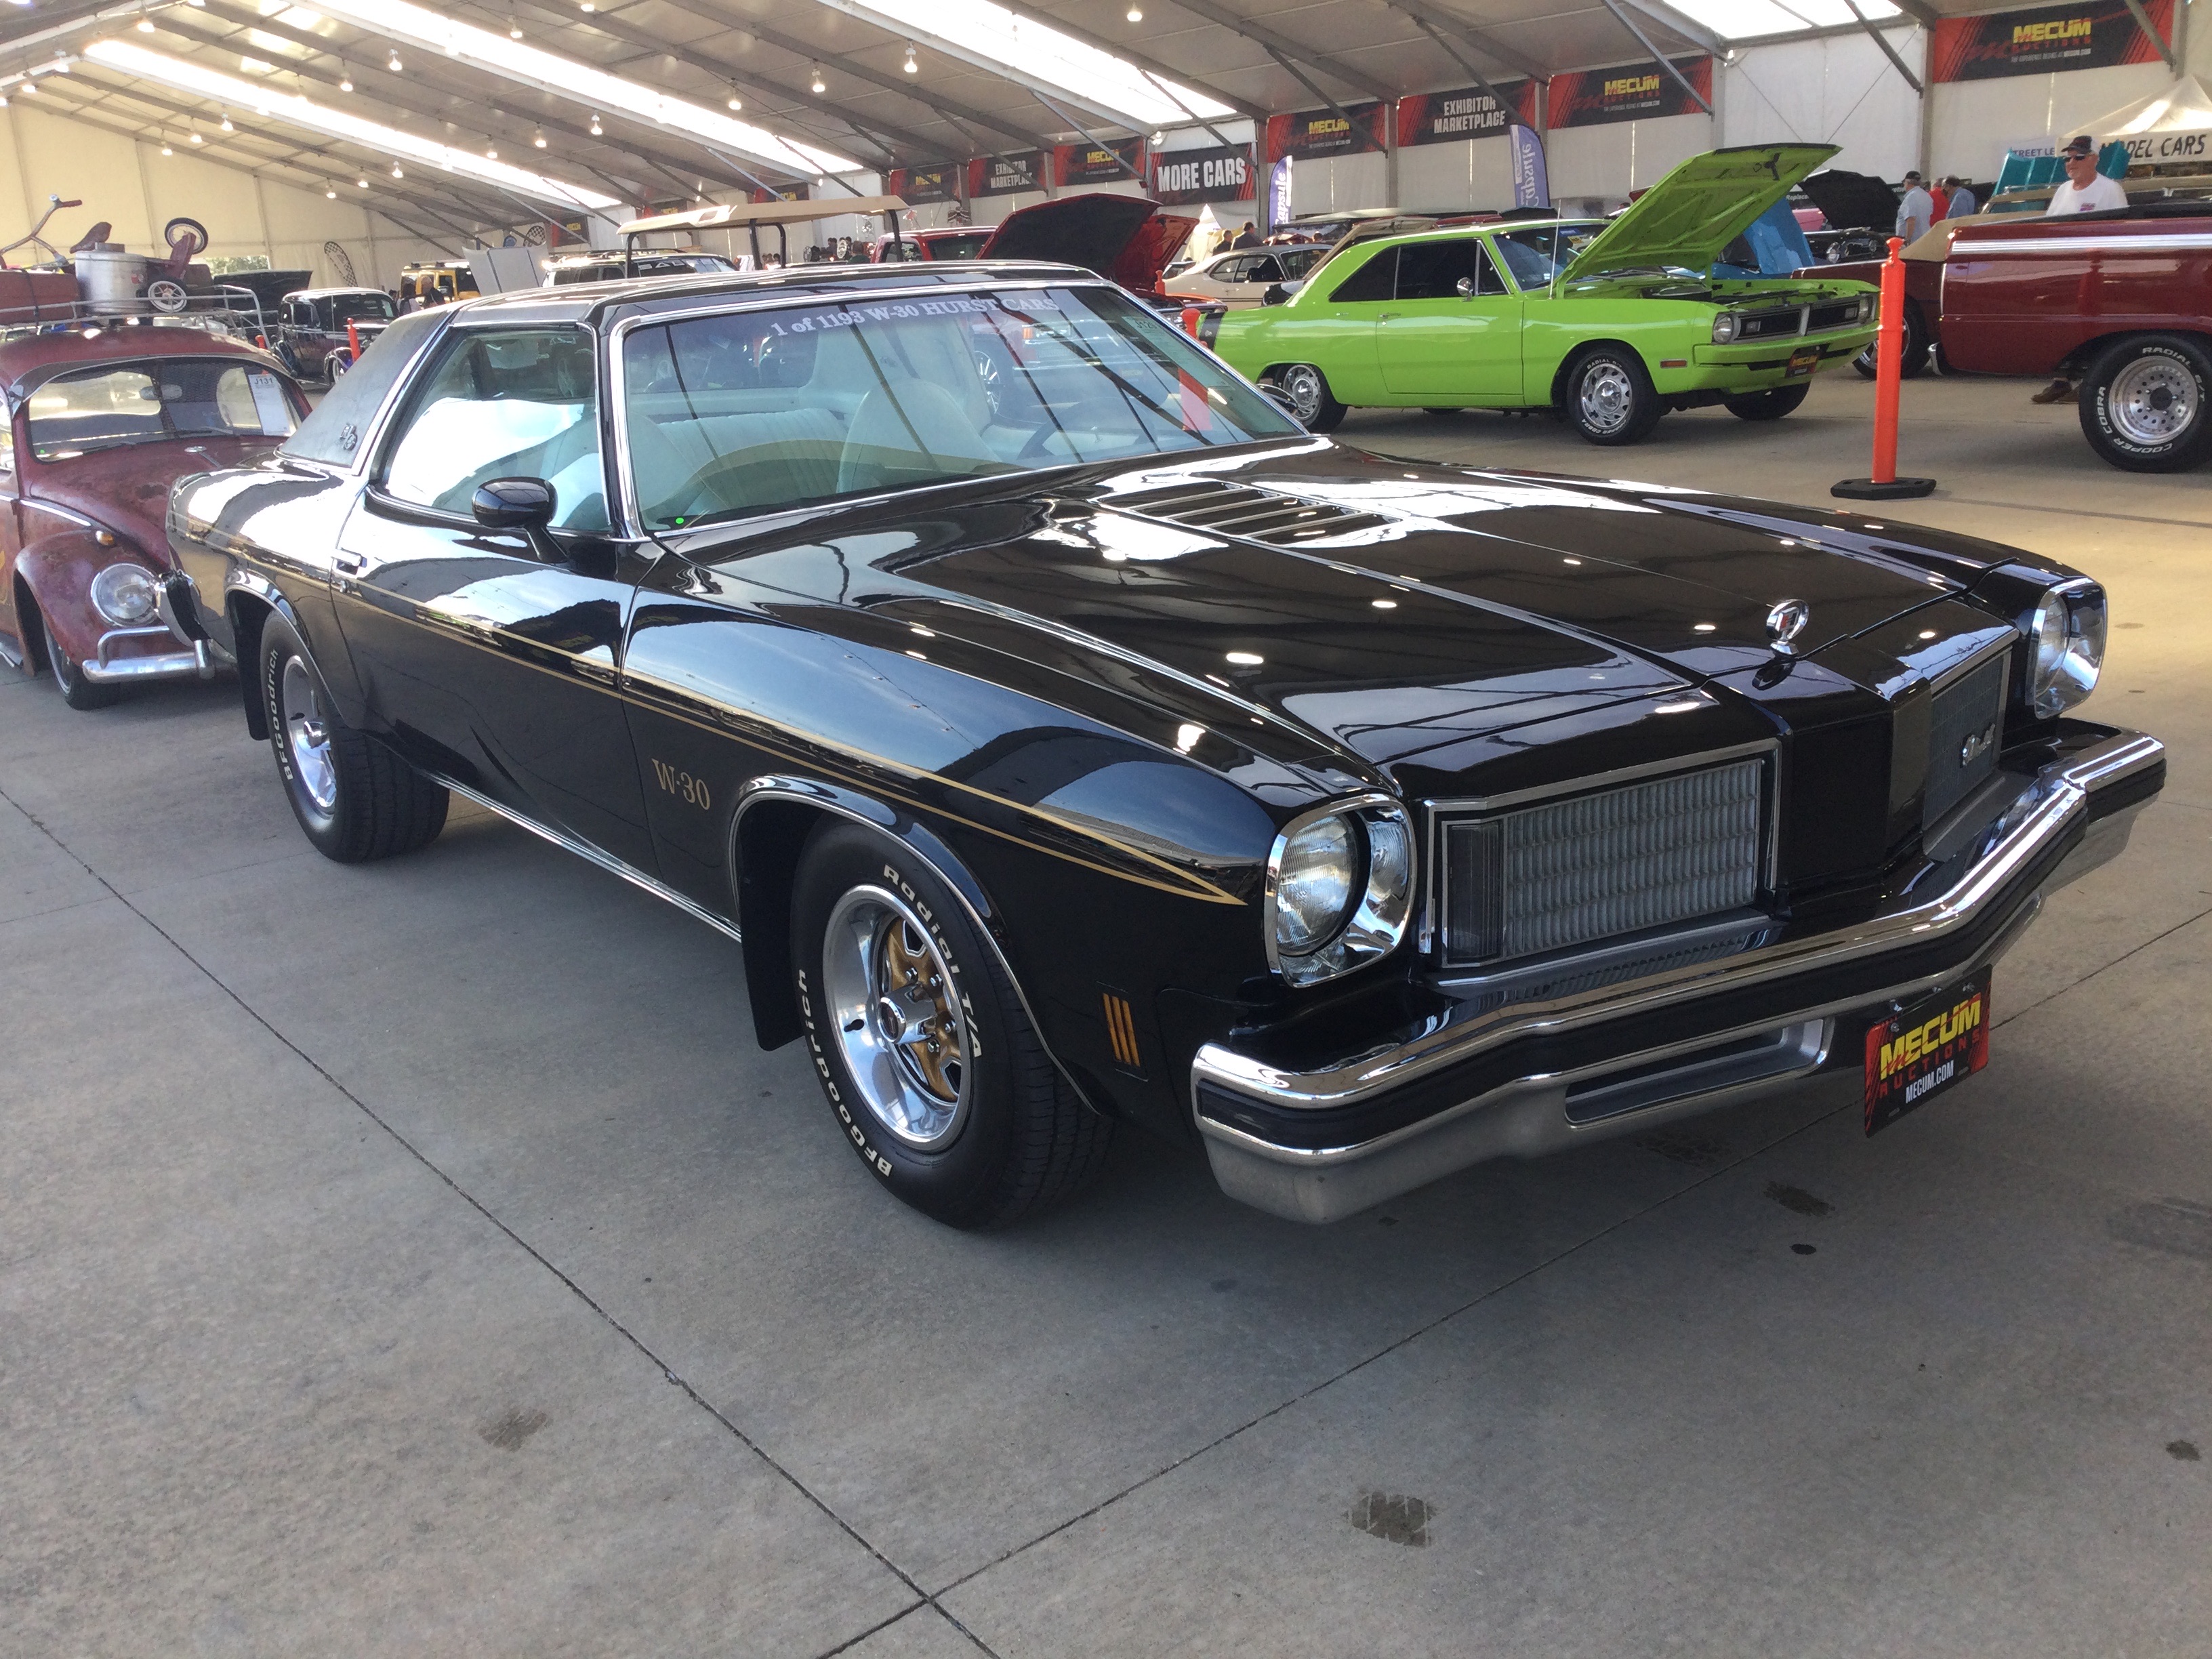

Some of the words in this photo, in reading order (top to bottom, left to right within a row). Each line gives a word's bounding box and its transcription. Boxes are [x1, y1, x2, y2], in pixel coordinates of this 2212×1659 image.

[2013, 18, 2091, 43] MECUM
[1604, 74, 1660, 96] MECUM
[1434, 110, 1506, 134] MARKETPLACE
[1443, 96, 1496, 116] EXHIBITOR
[1309, 119, 1350, 135] MECUM
[2012, 148, 2043, 157] TREET
[2160, 134, 2207, 156] CARS
[1158, 163, 1200, 192] MORE
[1204, 157, 1246, 187] CARS
[771, 323, 788, 336] 1
[791, 317, 816, 333] of
[817, 311, 865, 329] 1193
[863, 305, 920, 321] W-30
[919, 299, 1000, 316] HURST
[1000, 298, 1060, 312] CARS
[2142, 347, 2191, 369] RADIAL
[2097, 386, 2113, 434] COBRA
[2113, 438, 2173, 454] COOPER
[267, 649, 293, 780] BFGoodrich
[651, 758, 710, 810] W-30
[883, 864, 960, 974] Radial
[960, 991, 983, 1058] T/A
[1880, 992, 1981, 1081] MECUM
[798, 969, 893, 1177] BFGoodrich
[1879, 1029, 1980, 1099] AUCTIONS
[1906, 1060, 1954, 1104] MECUM.COM
